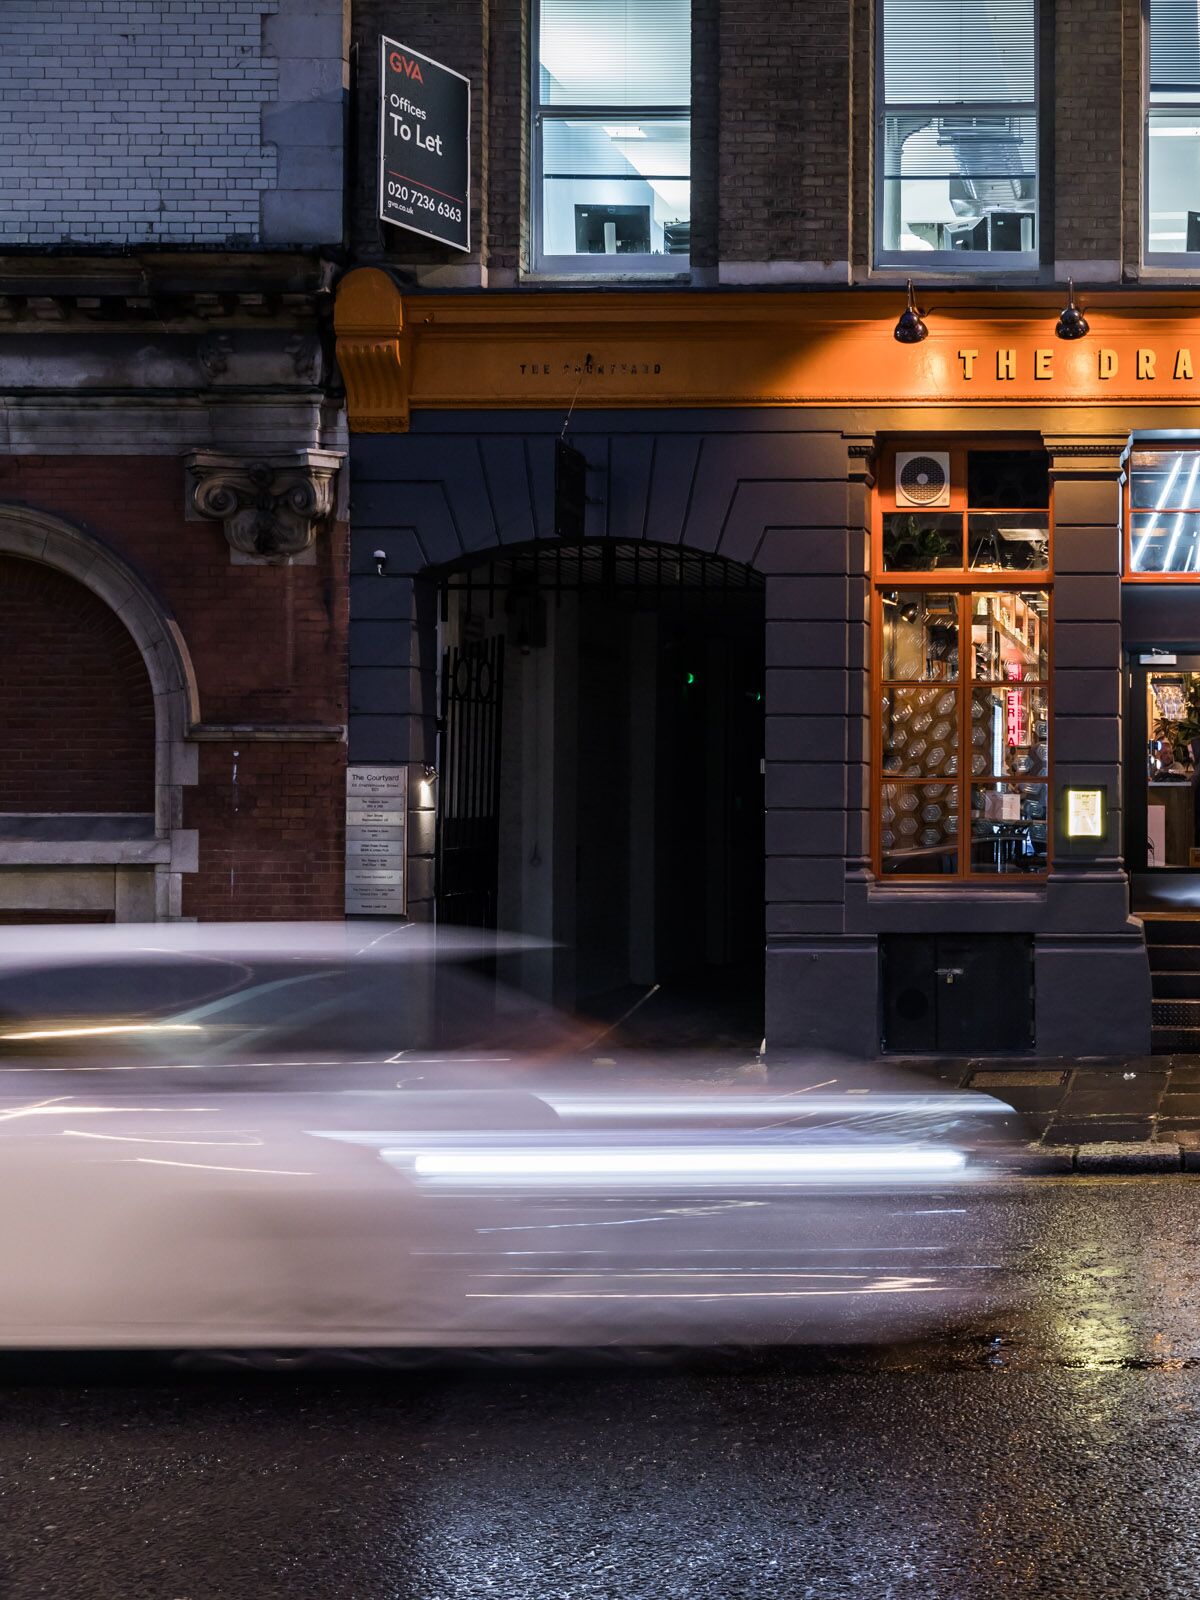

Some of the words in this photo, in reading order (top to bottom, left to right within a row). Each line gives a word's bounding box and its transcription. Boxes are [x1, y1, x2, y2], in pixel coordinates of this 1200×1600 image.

[389, 51, 424, 85] GVA
[390, 93, 427, 120] Offices
[389, 112, 411, 141] To
[416, 123, 443, 156] Let
[387, 200, 414, 215] gva.co.uk
[388, 181, 409, 201] 020
[410, 189, 435, 212] 7236
[437, 200, 462, 223] 6363
[520, 364, 551, 375] THE
[958, 349, 1054, 381] THE
[366, 774, 400, 782] Courtyard
